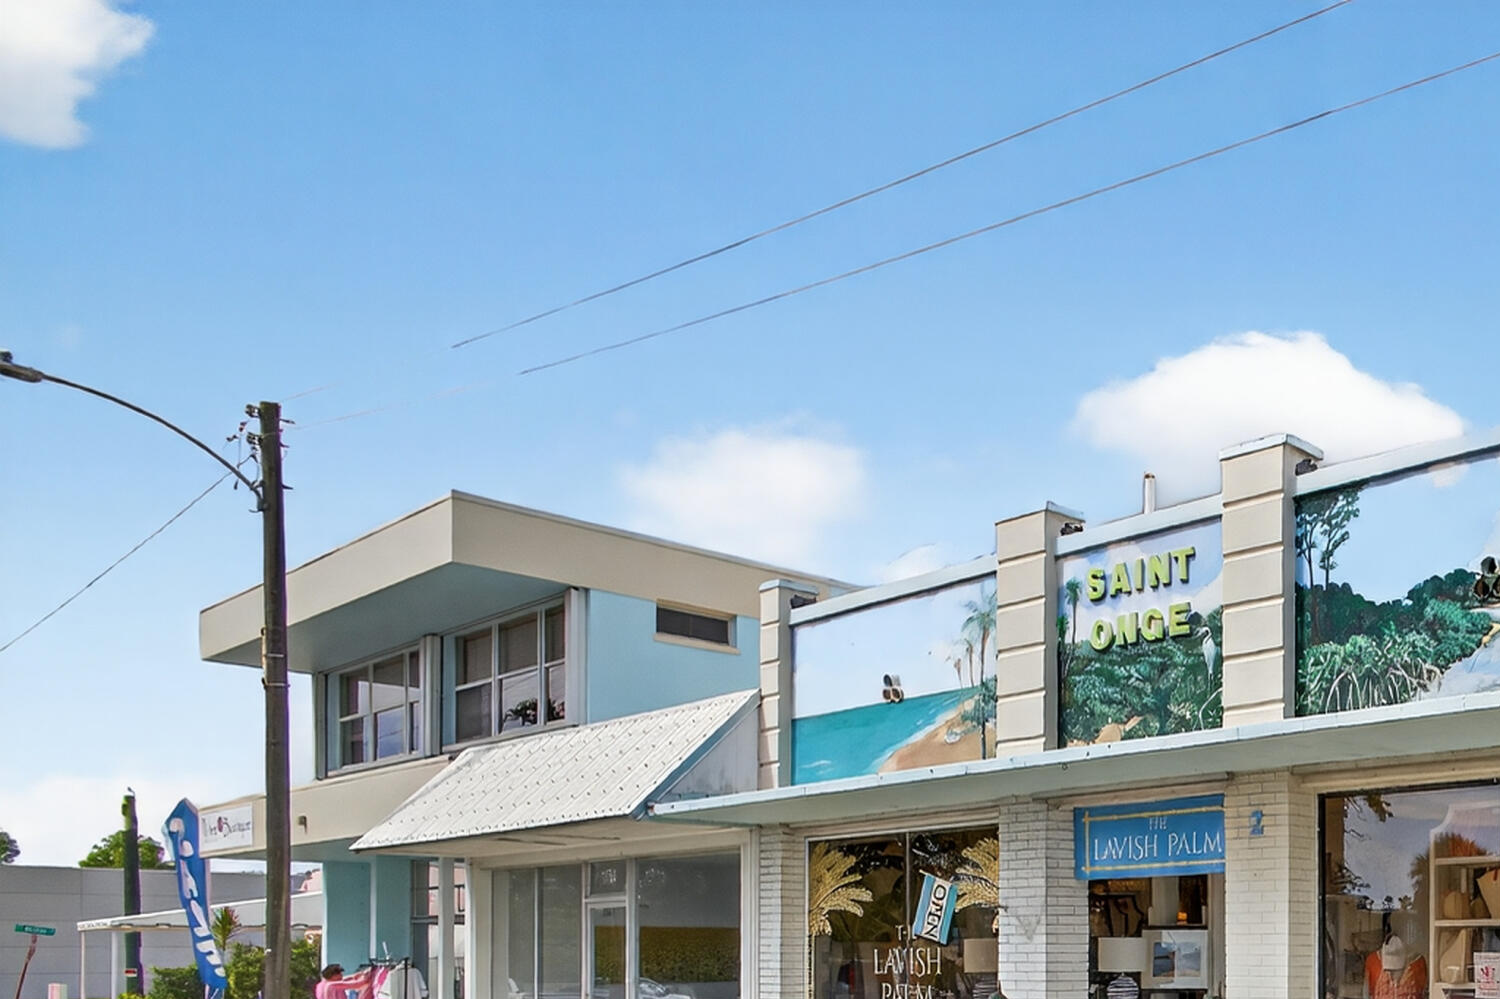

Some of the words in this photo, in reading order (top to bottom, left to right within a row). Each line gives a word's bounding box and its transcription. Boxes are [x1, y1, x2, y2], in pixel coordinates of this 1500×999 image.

[1087, 547, 1195, 601] SAINT
[1090, 602, 1191, 651] ONGE
[1250, 809, 1264, 835] 2
[1094, 833, 1158, 861] LAVISH
[1168, 831, 1222, 857] PALM
[874, 948, 941, 977] LAVISH
